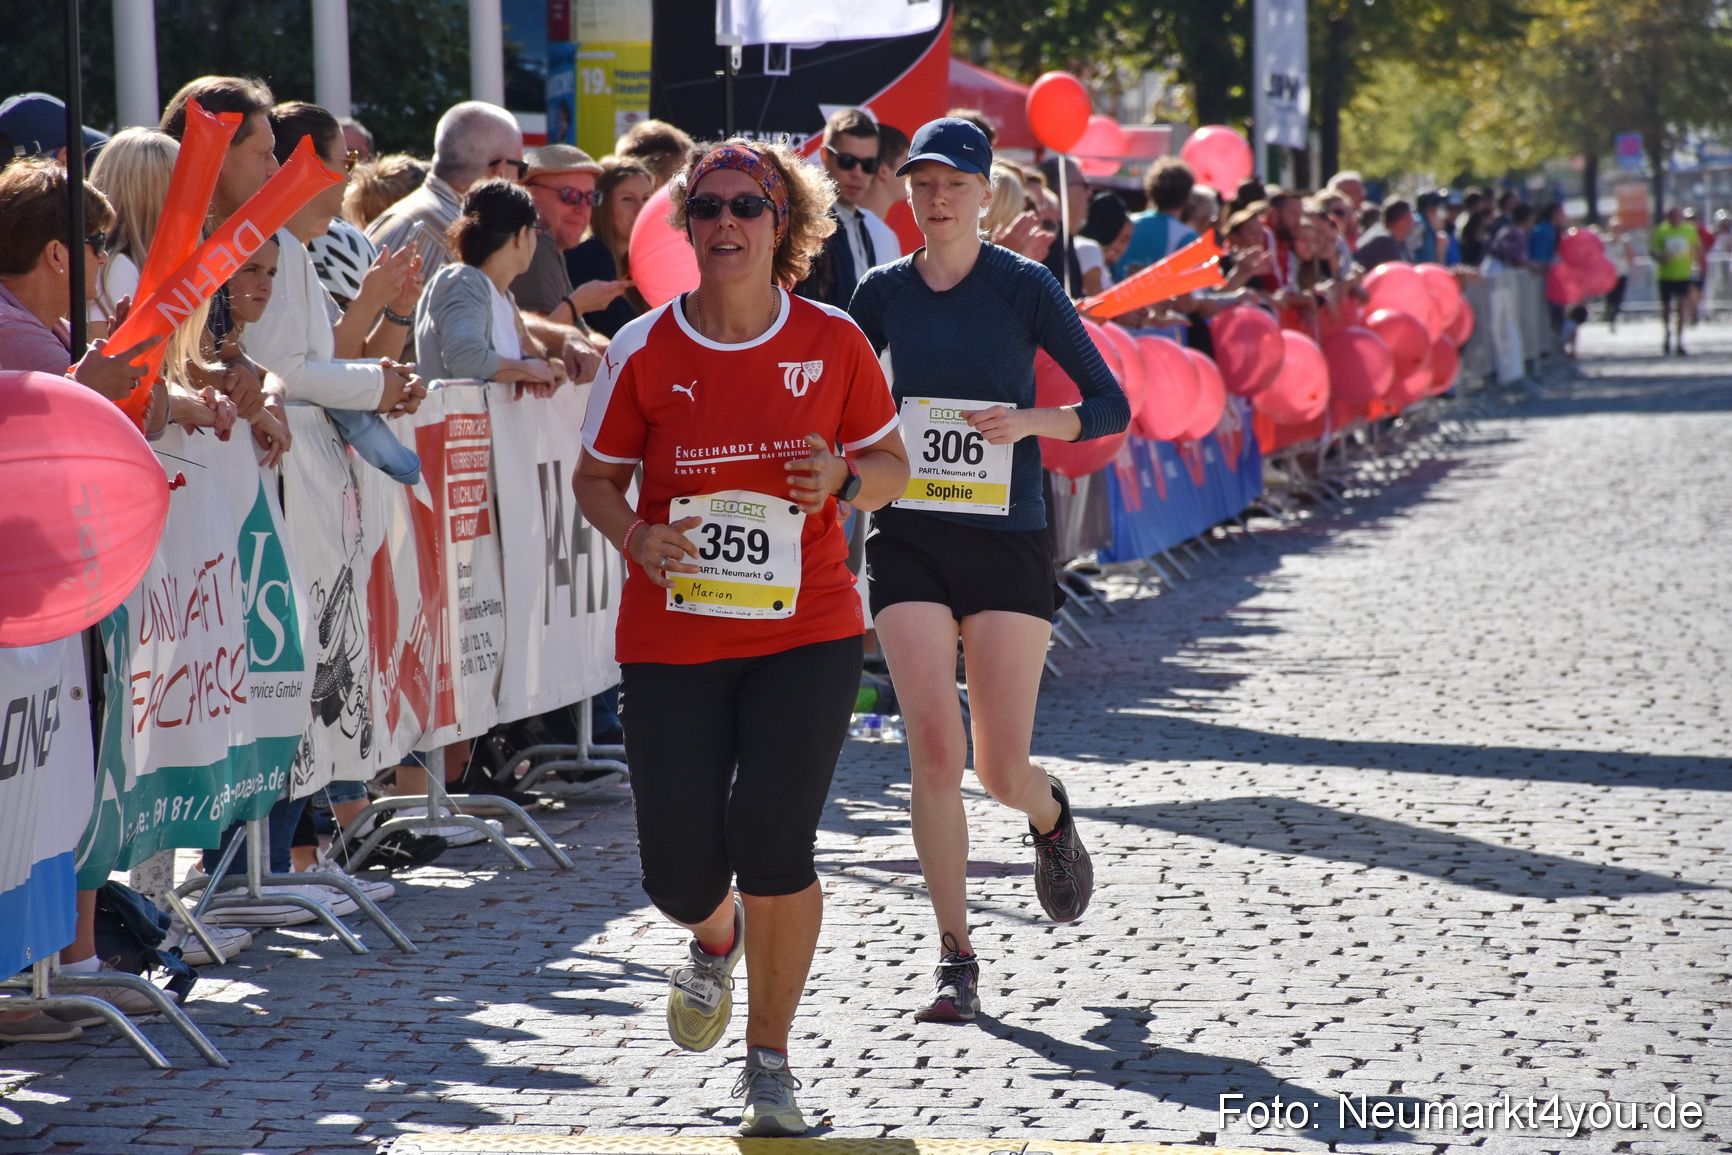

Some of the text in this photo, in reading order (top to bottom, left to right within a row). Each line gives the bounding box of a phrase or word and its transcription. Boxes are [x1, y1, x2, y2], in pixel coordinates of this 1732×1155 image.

[581, 67, 612, 94] 19.
[156, 219, 266, 329] DEHN
[675, 439, 811, 459] ENGELHARDT & WALTE
[923, 429, 984, 465] 306
[674, 466, 717, 475] Amberg
[918, 467, 976, 478] PARTL Neumarkt
[926, 482, 973, 501] Sophie
[710, 499, 767, 518] BOCK
[699, 523, 770, 565] 359
[699, 566, 761, 579] ARTL Neumarkt
[691, 582, 733, 600] Marion
[276, 681, 303, 698] GmbH
